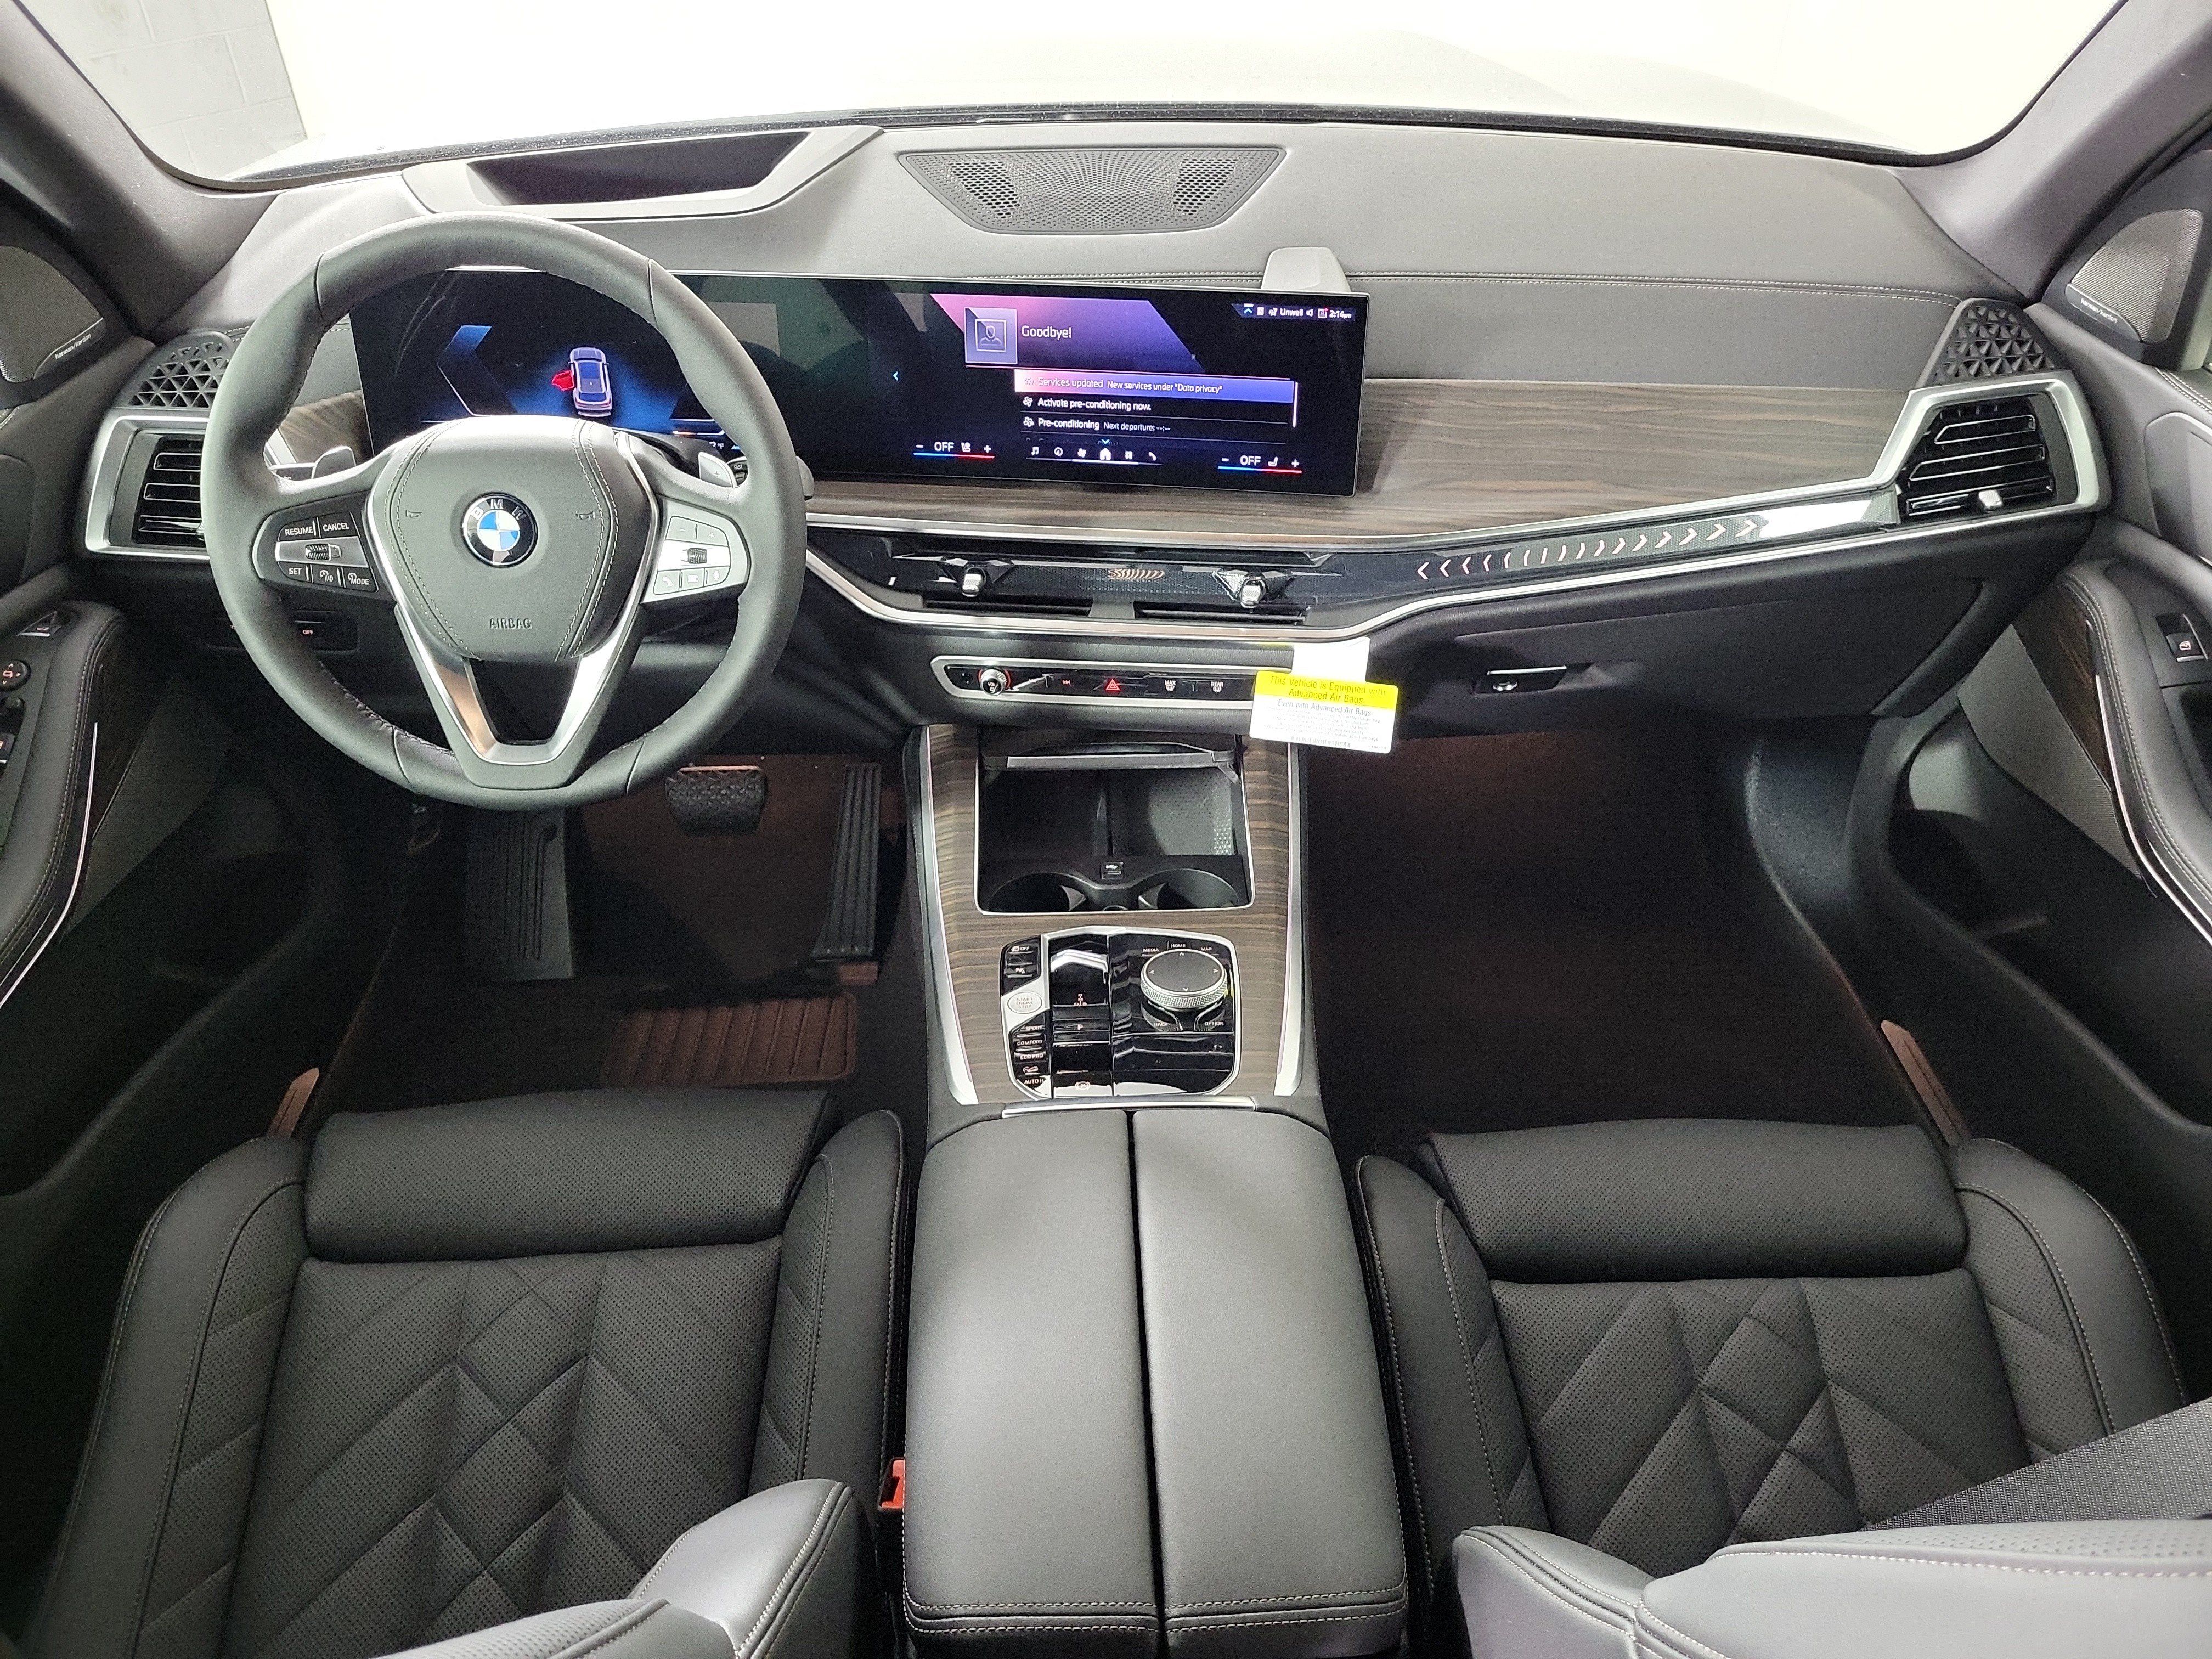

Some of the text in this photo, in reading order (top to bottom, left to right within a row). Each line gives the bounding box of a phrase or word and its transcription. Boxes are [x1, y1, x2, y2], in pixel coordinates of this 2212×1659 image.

[1280, 308, 1304, 317] Unwell
[1021, 325, 1072, 340] Goodbye!
[55, 334, 92, 360] harman/kardon
[1037, 377, 1223, 394] Services updated New services under "Data privacy"
[1037, 398, 1069, 407] Activate
[1070, 400, 1132, 412] pre-conditioning
[1038, 417, 1100, 431] Pre-conditioning
[1103, 421, 1119, 430] Next
[1120, 422, 1155, 432] departure:
[934, 441, 955, 452] OFF
[1240, 455, 1261, 466] OFF
[470, 498, 527, 521] BMW
[284, 526, 314, 536] RESUME
[323, 522, 350, 532] CANCEL
[289, 567, 302, 575] SET
[351, 577, 370, 585] MODE
[489, 618, 533, 629] AIRBAG
[1270, 675, 1286, 685] This
[1289, 678, 1317, 689] Vehicle
[1329, 682, 1366, 695] Equipped
[1369, 688, 1386, 696] with
[1288, 688, 1364, 705] Advanced Air Bags
[1278, 698, 1294, 707] Even
[1310, 702, 1342, 713] Advanced
[1355, 708, 1372, 716] Bags
